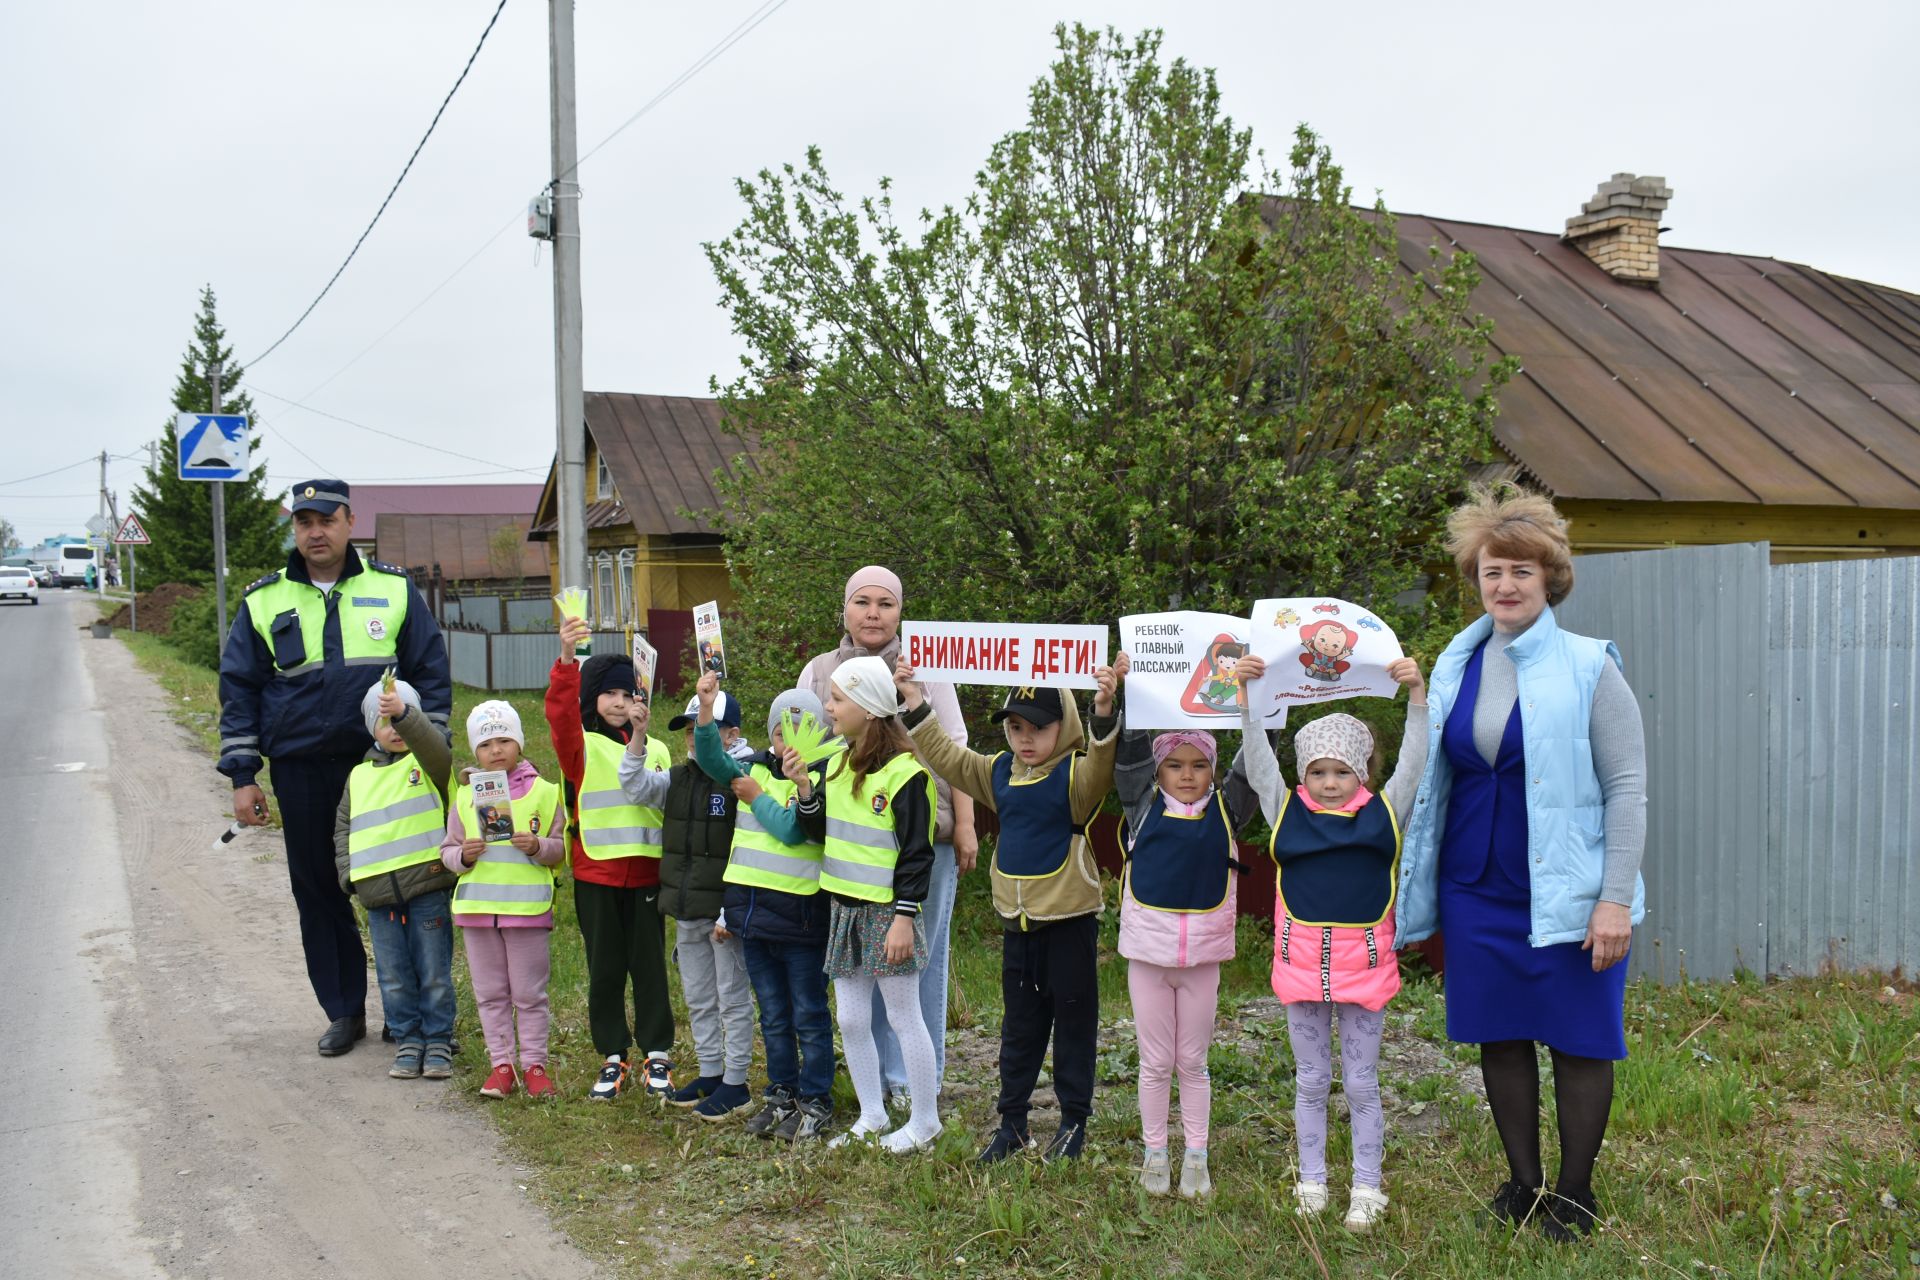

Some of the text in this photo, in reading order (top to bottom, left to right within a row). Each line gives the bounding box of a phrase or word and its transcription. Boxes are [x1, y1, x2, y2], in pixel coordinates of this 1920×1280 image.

[1135, 624, 1184, 636] РЕБЕНОК-
[910, 635, 1097, 680] ВНИМАНИЕ ДЕТИ!
[1135, 641, 1184, 654] ГЛАВНЫЙ
[1133, 660, 1191, 673] ПАССАЖИР!
[709, 793, 726, 816] R
[1323, 928, 1331, 949] LOVE
[1365, 929, 1376, 951] LOVE
[1321, 949, 1330, 969] LOVE
[1321, 969, 1330, 990] LOVE
